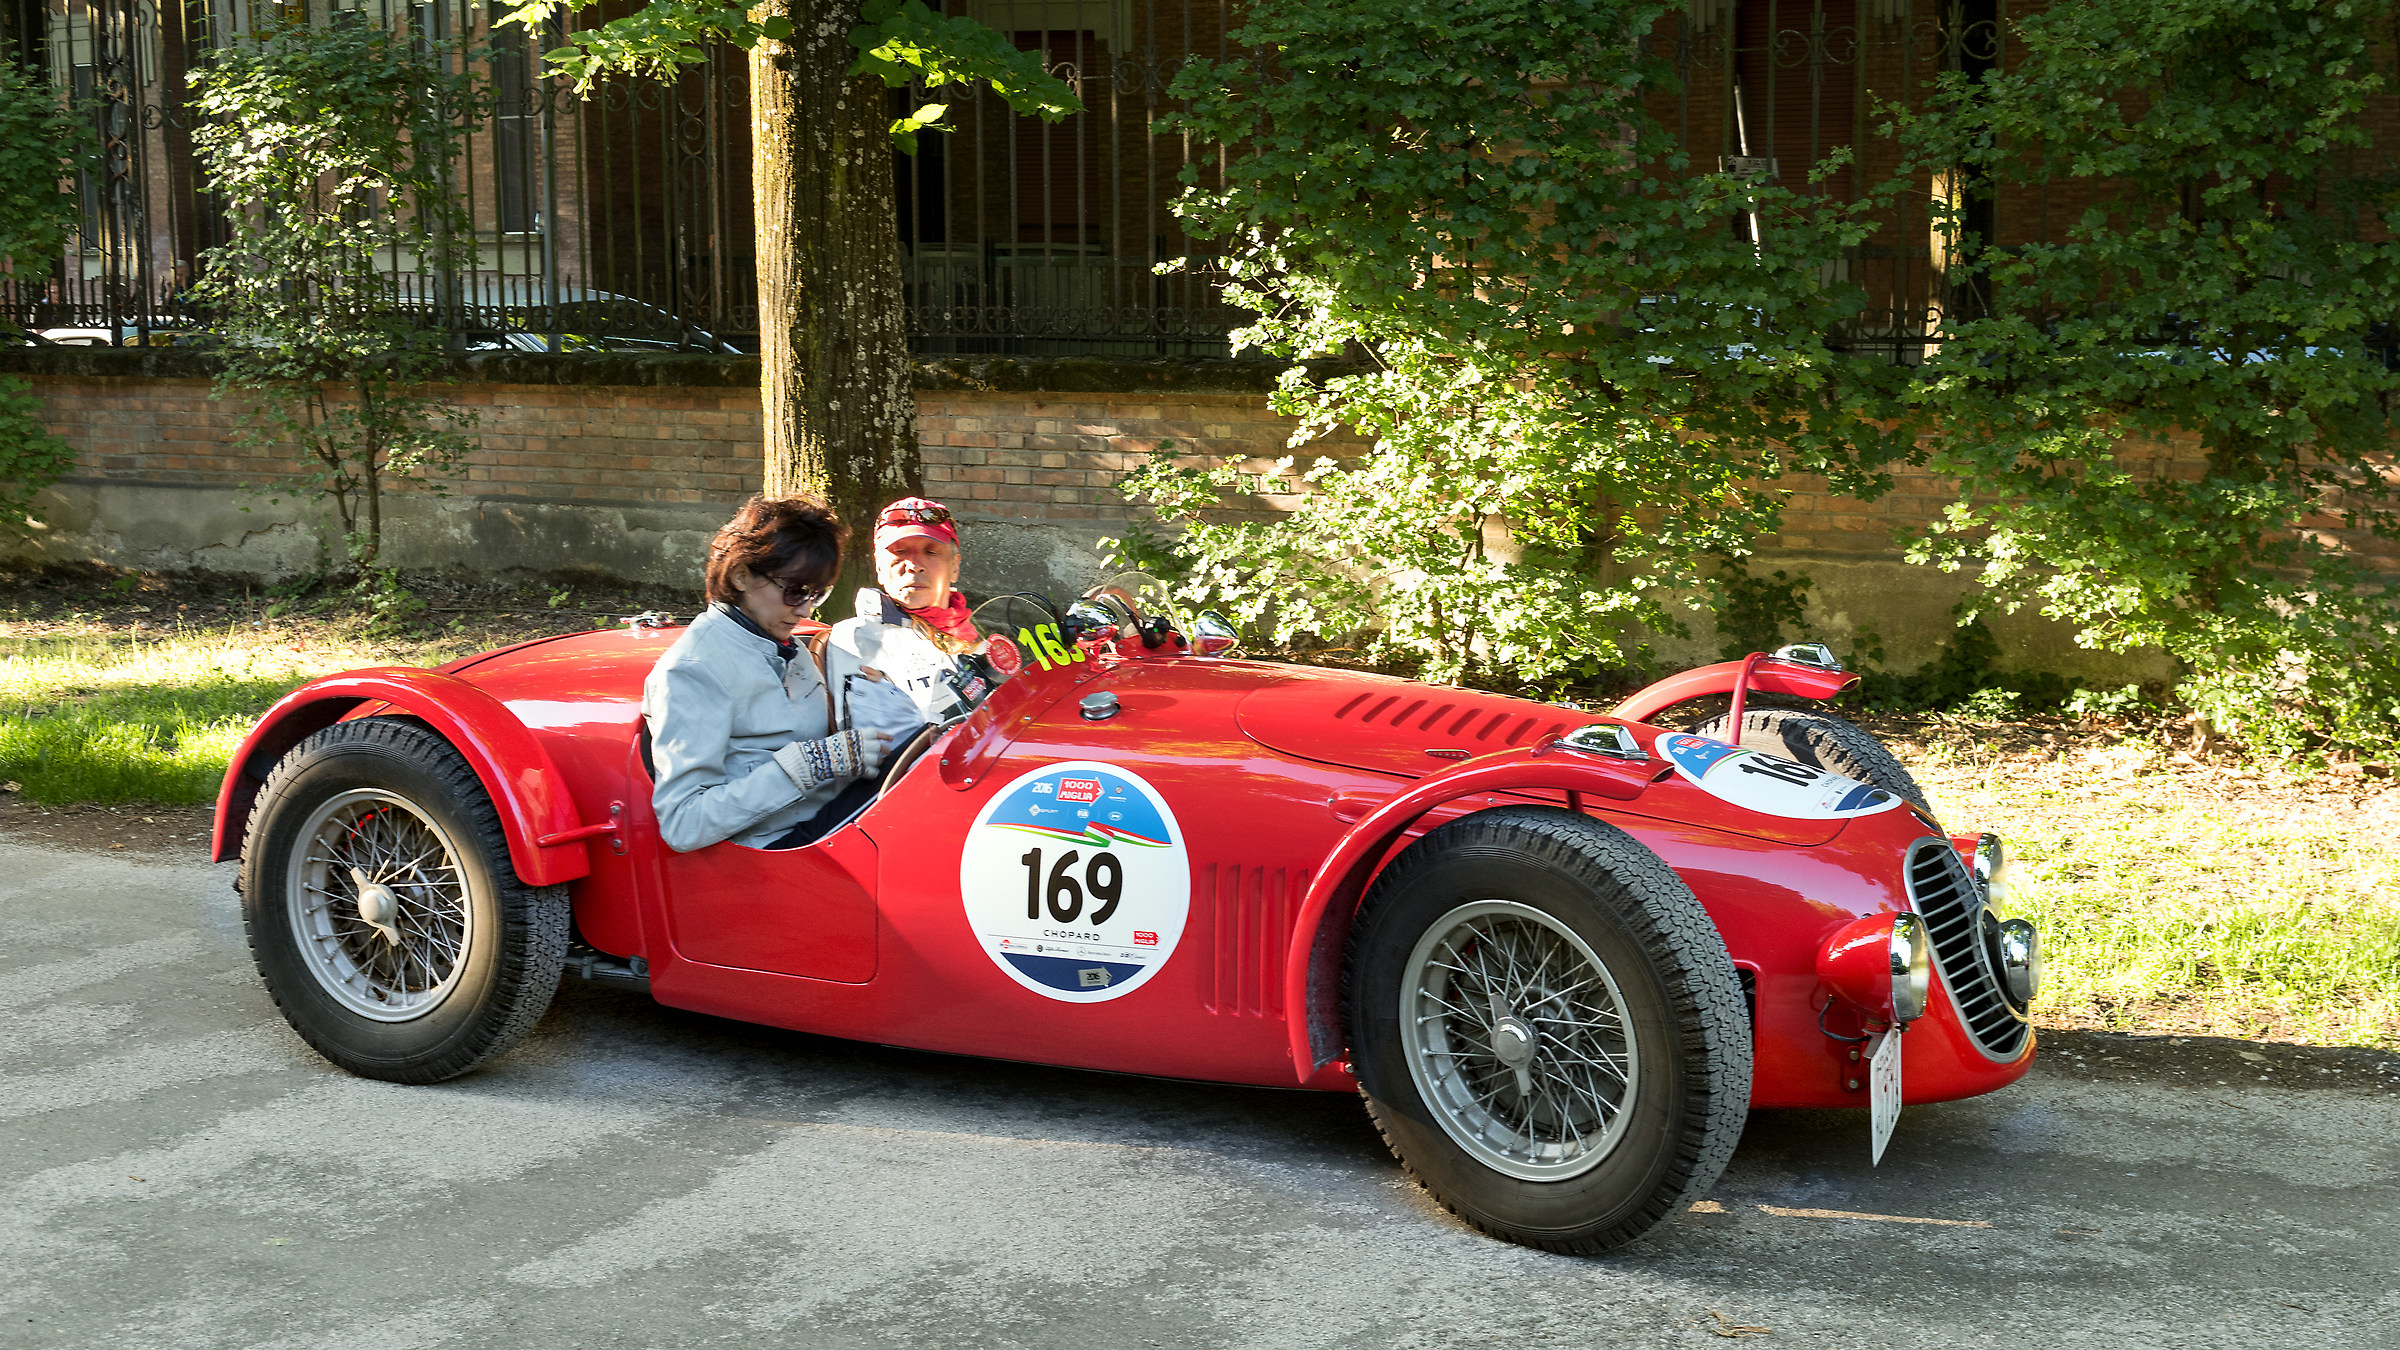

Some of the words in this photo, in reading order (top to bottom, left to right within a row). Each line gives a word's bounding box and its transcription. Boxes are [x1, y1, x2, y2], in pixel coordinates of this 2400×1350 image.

[1031, 782, 1053, 794] 2016
[1064, 780, 1093, 790] 1000
[1060, 790, 1093, 801] MIGLIA
[1021, 847, 1123, 926] 169
[1043, 929, 1101, 941] CHOPARD
